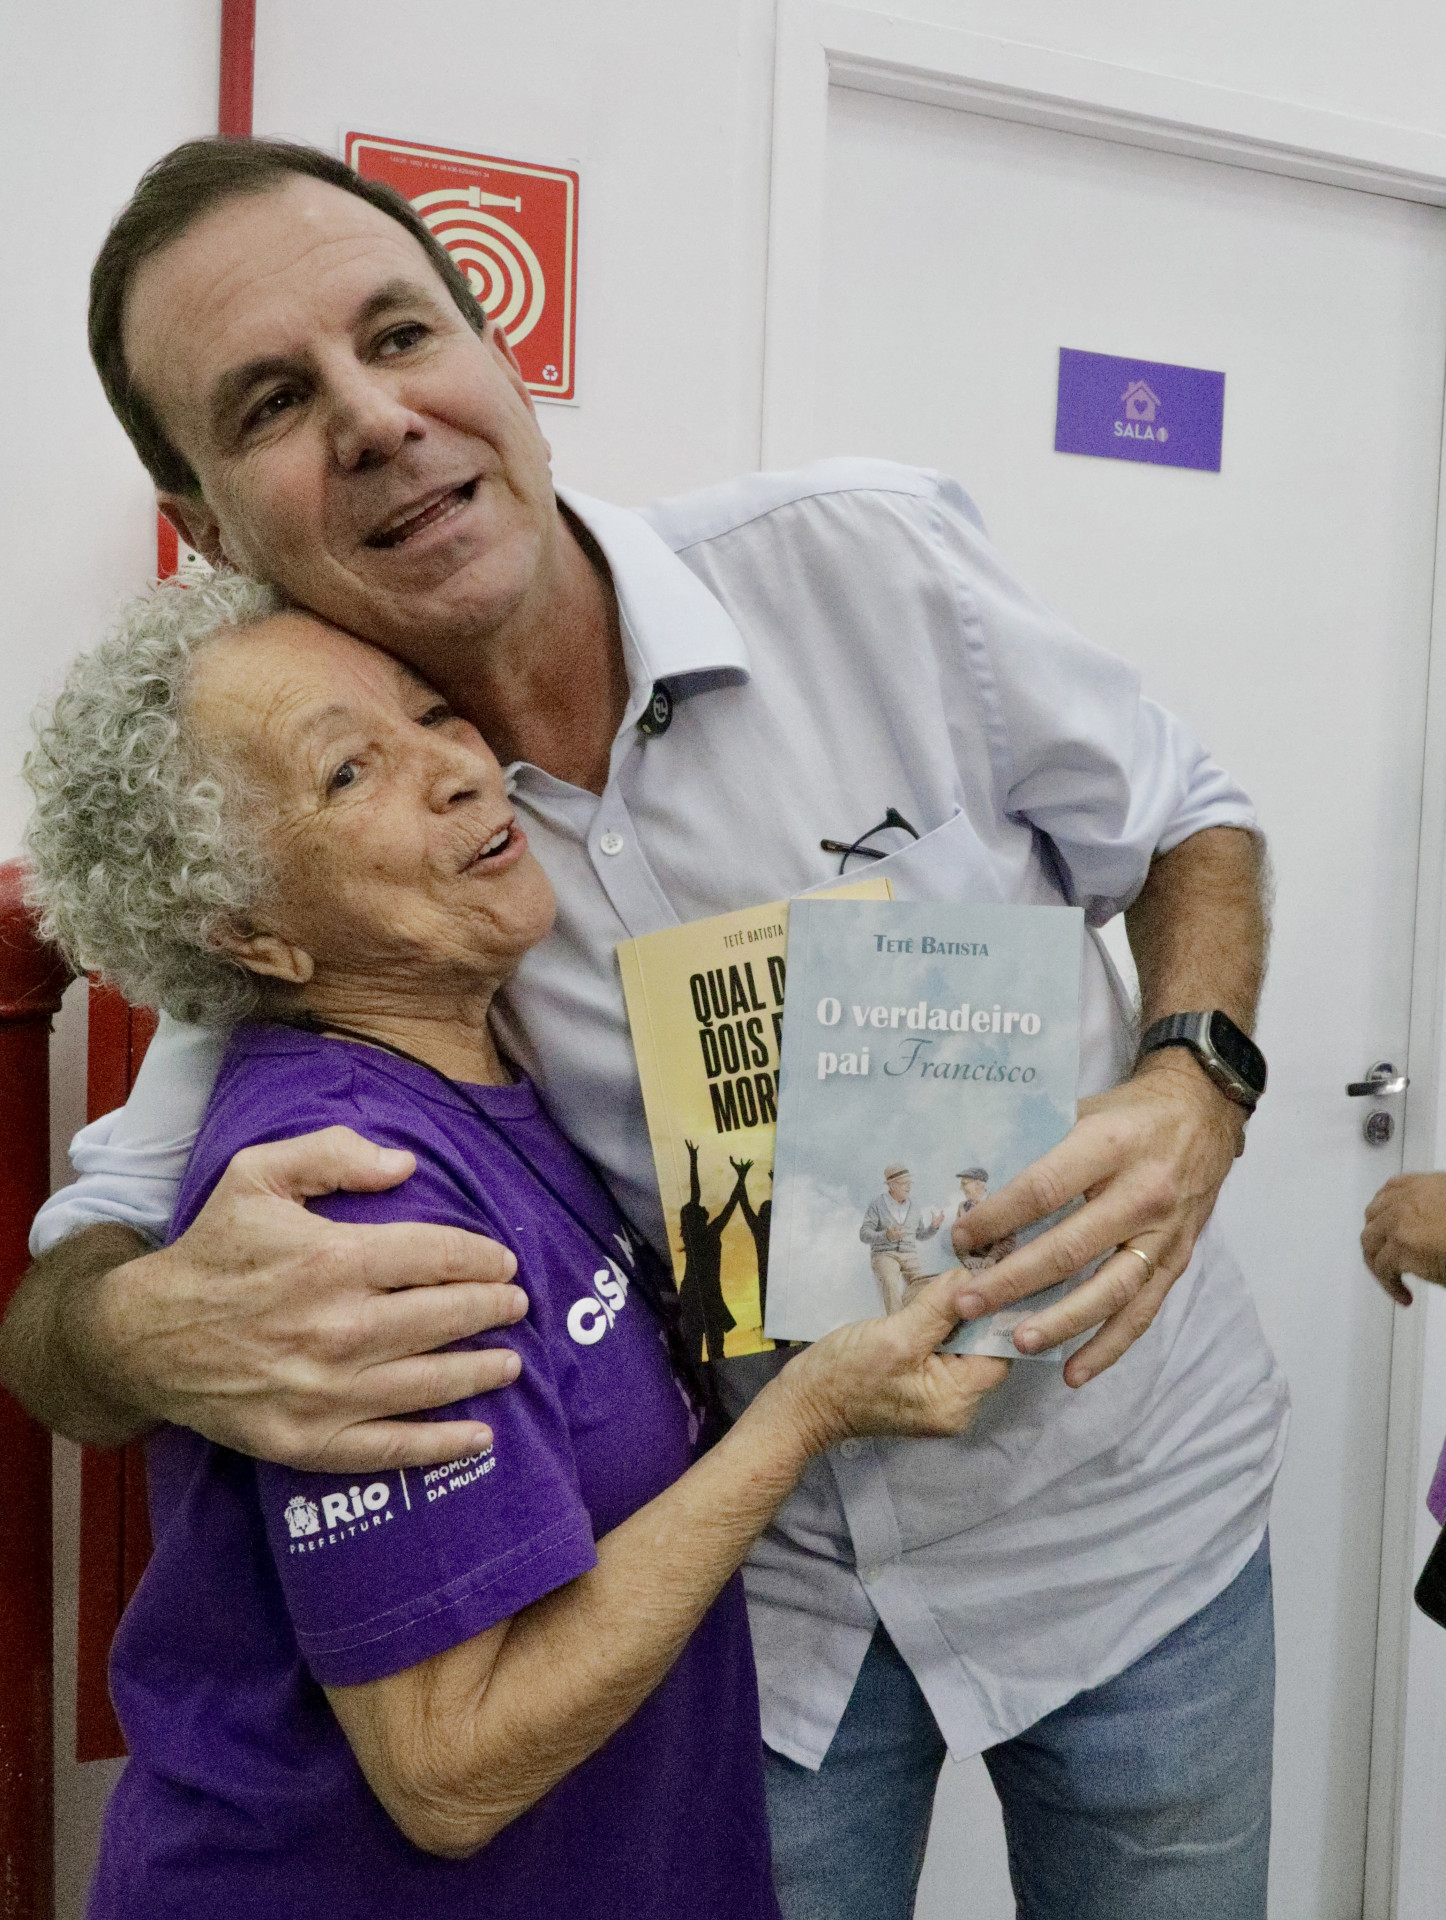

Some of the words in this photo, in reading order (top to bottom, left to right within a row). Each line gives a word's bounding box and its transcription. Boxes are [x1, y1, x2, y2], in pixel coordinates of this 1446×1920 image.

[1114, 421, 1154, 441] SALA
[1156, 427, 1169, 443] 1
[723, 930, 745, 948] TETÊ
[747, 924, 784, 943] BATISTA
[689, 962, 767, 1027] QUAL
[817, 997, 842, 1026] O
[851, 1001, 1042, 1036] verdadeiro
[699, 1017, 769, 1079] DOIS
[817, 1046, 870, 1080] pai
[883, 1038, 1036, 1083] Francisco
[709, 1069, 779, 1134] MOR
[427, 1485, 448, 1503] DA
[449, 1457, 496, 1491] MULHER
[289, 1510, 395, 1555] PREFEITURA
